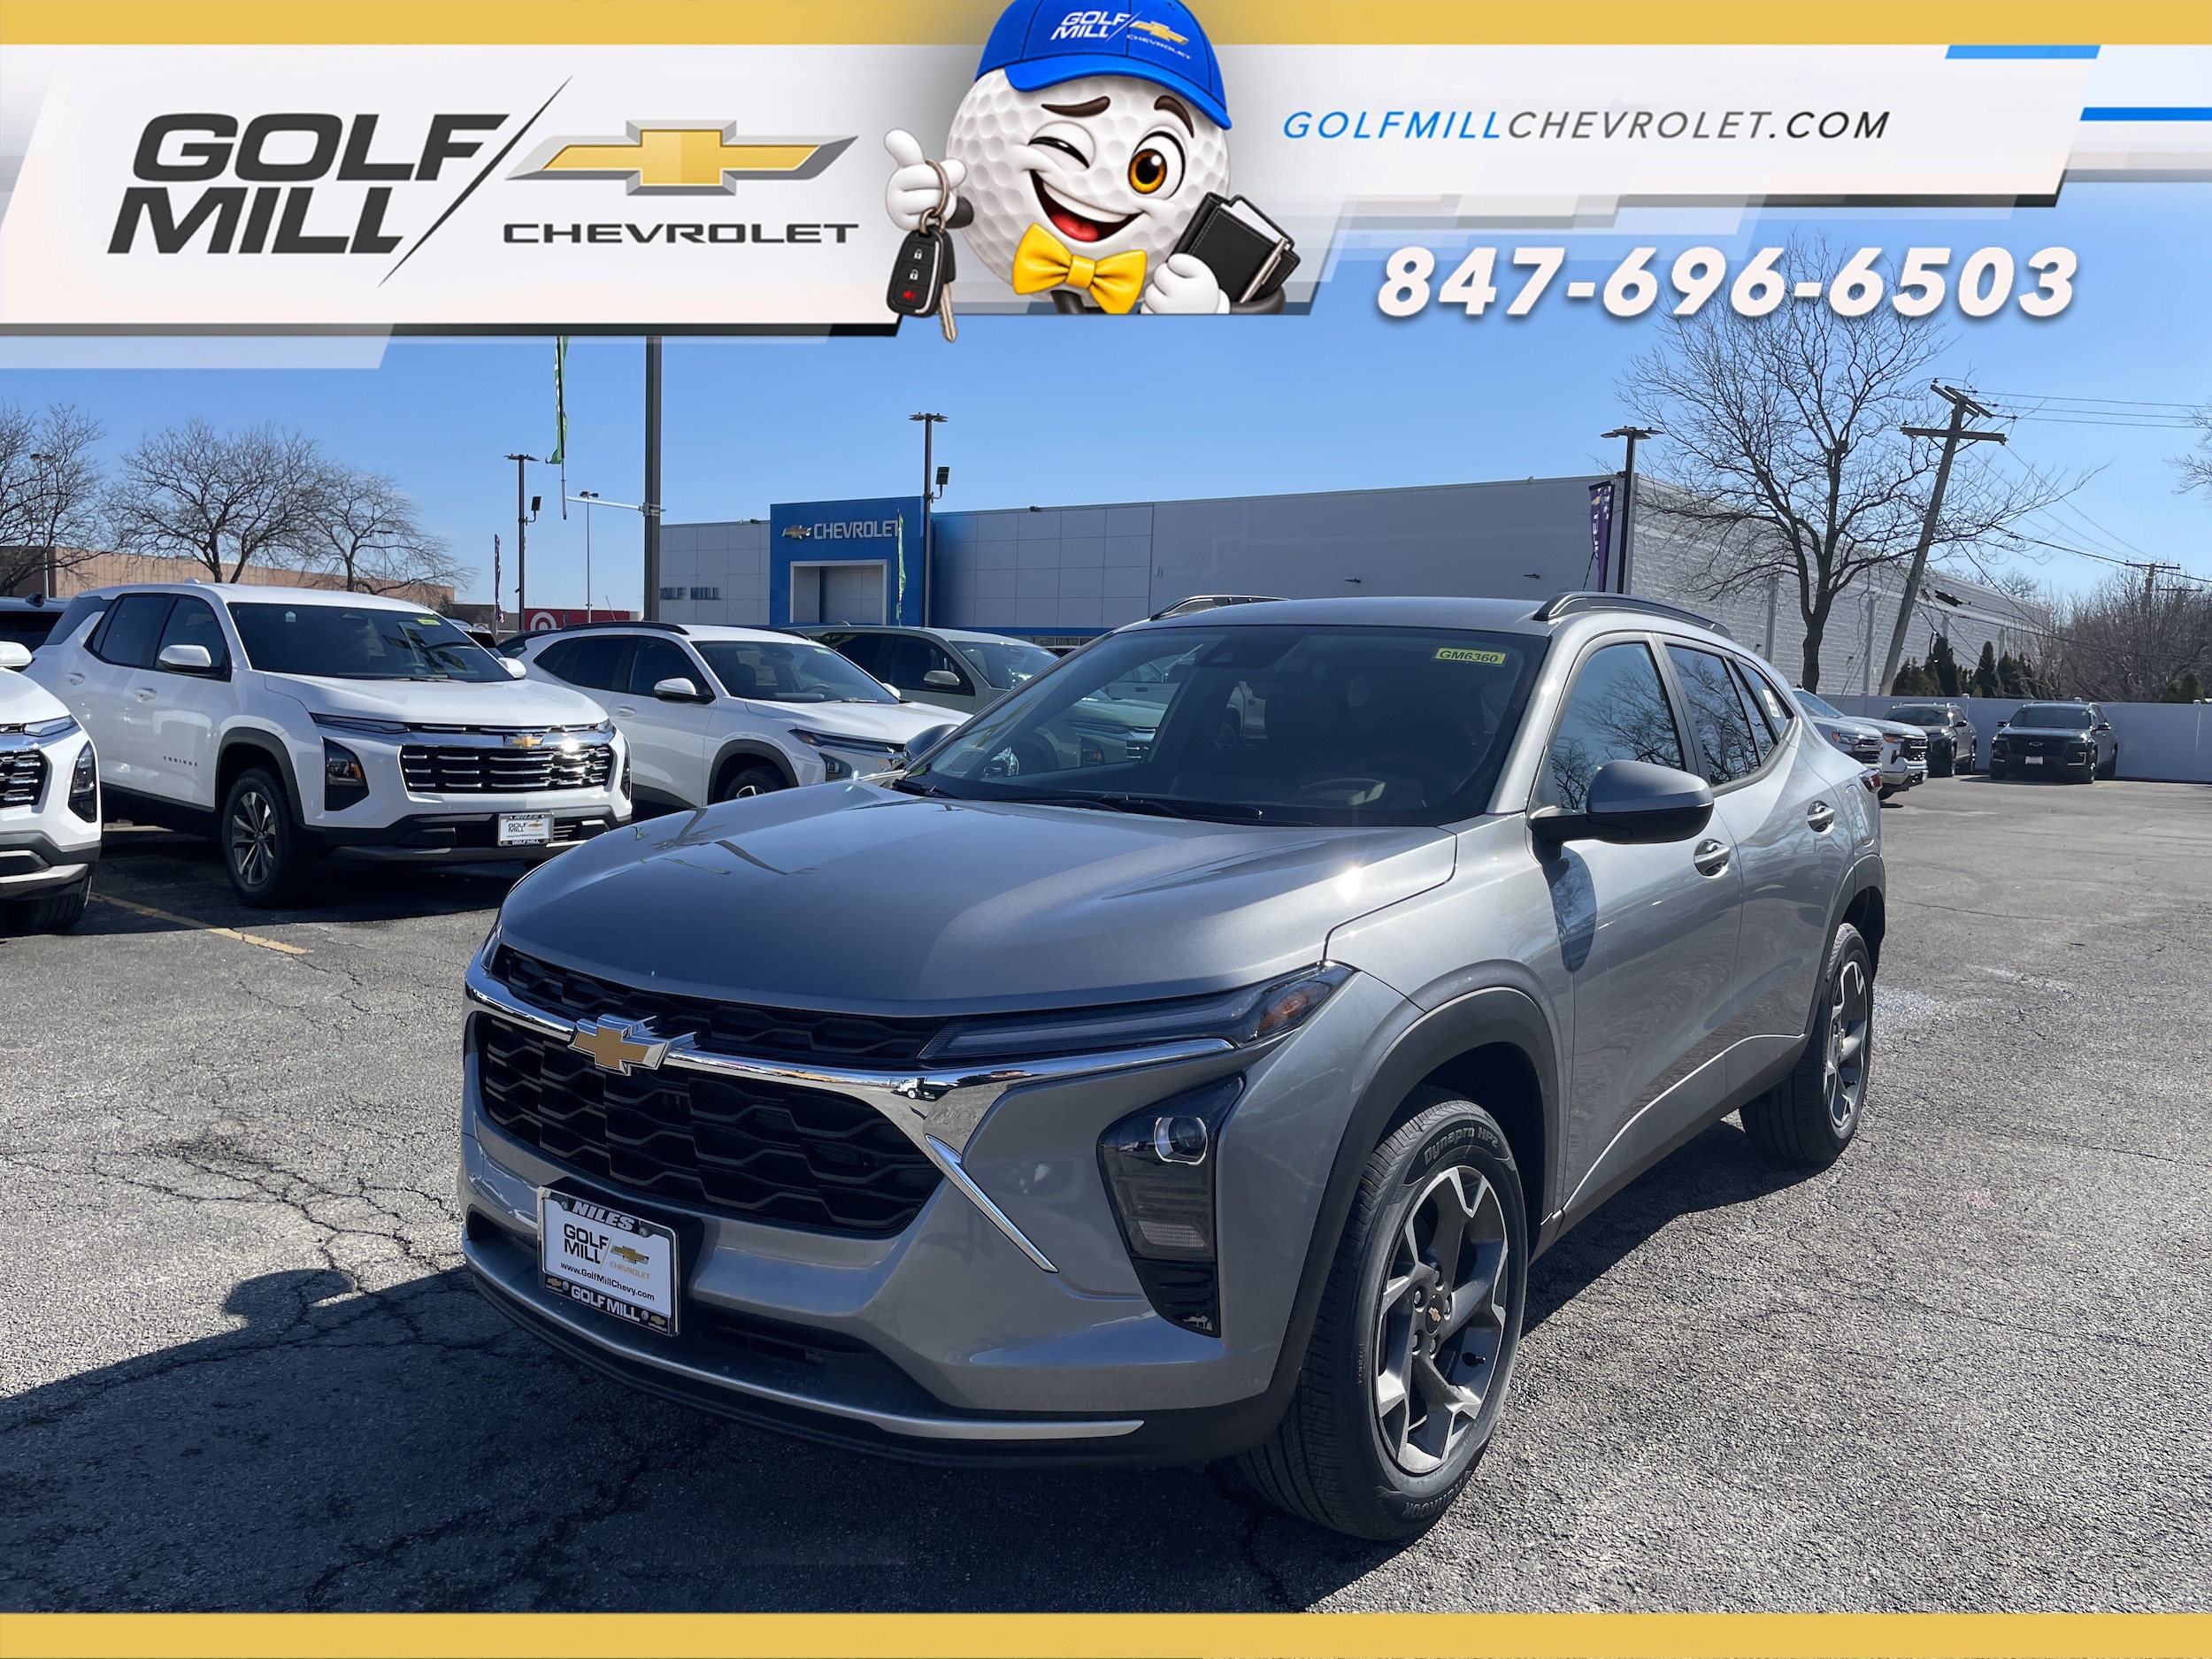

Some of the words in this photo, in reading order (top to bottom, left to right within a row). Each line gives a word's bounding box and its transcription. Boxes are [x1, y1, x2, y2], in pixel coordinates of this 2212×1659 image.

[814, 520, 899, 540] CHEVROLET
[1440, 650, 1499, 663] GM6360
[1424, 1126, 1475, 1165] Dynapro
[1478, 1126, 1499, 1148] HP2
[572, 1201, 634, 1231] NILES
[564, 1223, 610, 1250] GOLF
[564, 1240, 602, 1265] MILL
[561, 1262, 655, 1301] www.GolfMillChevy.com
[611, 1262, 651, 1280] CHEVROLET
[572, 1286, 606, 1308] GOLF
[607, 1300, 640, 1322] MILL
